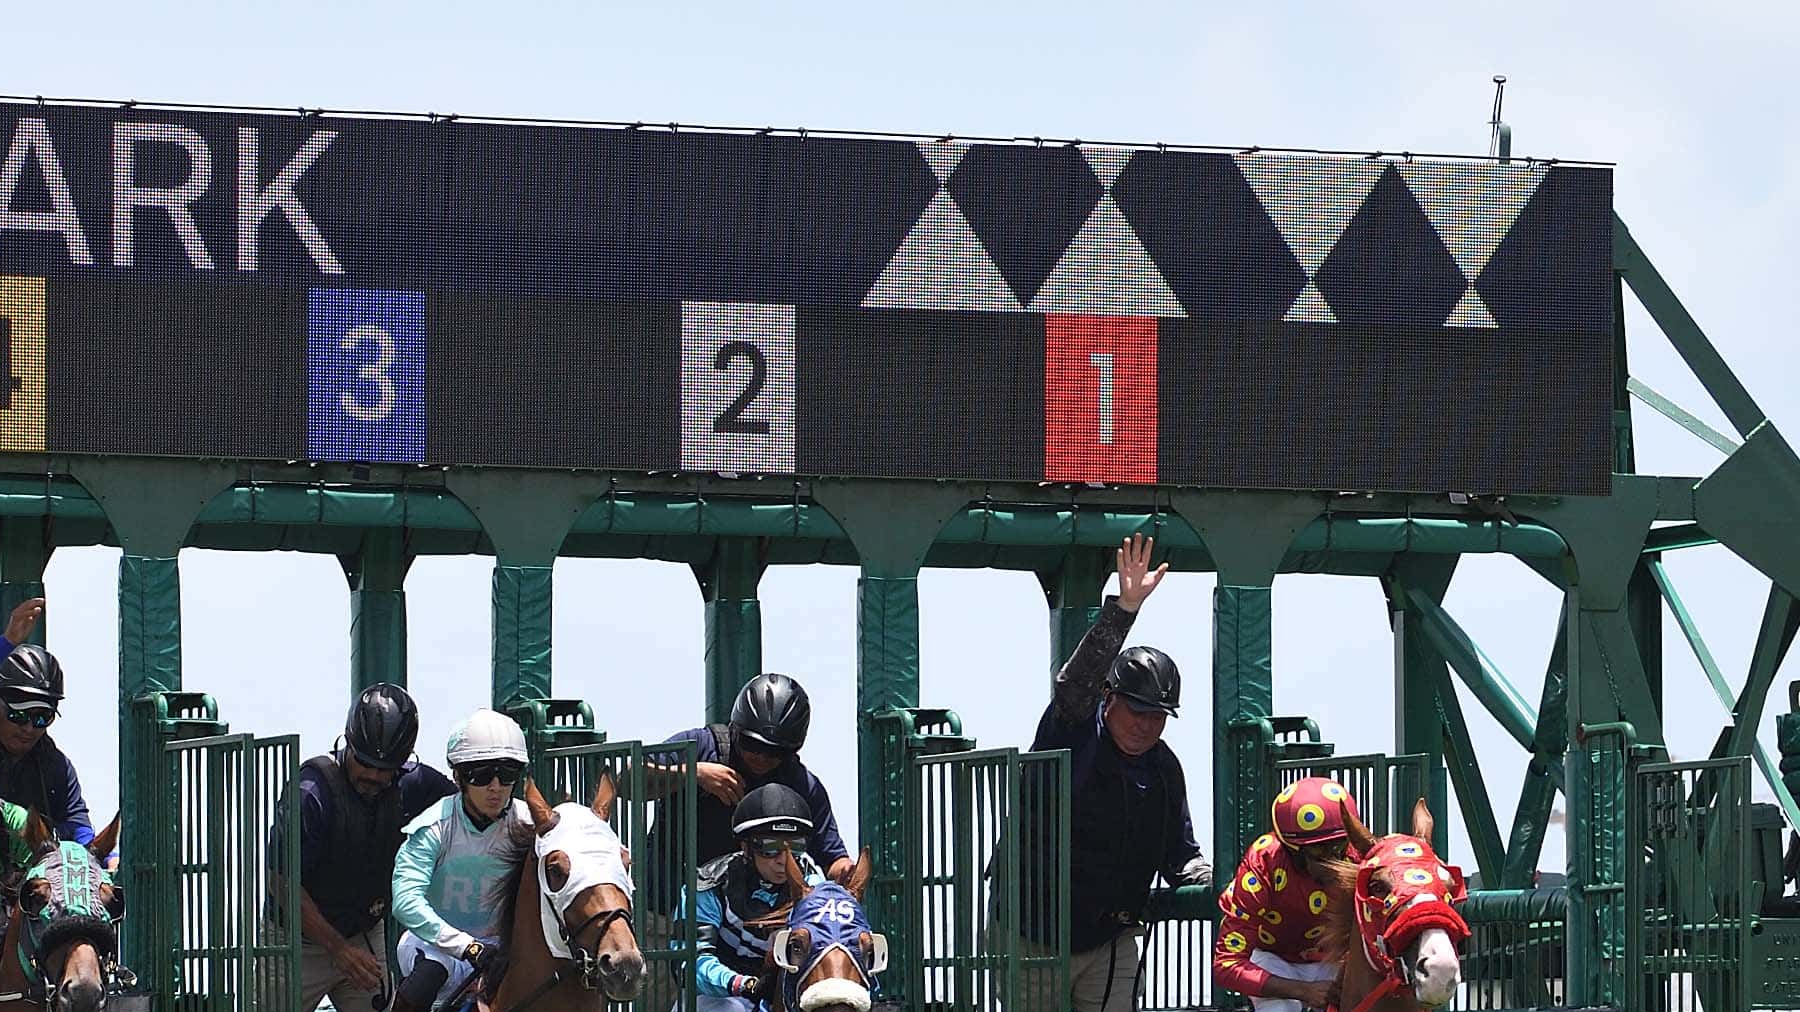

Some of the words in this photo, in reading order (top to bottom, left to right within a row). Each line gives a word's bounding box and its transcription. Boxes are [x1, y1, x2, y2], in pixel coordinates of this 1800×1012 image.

[339, 323, 398, 422] 3
[712, 340, 771, 435] 2
[1089, 352, 1114, 446] 1
[813, 898, 856, 924] AS
